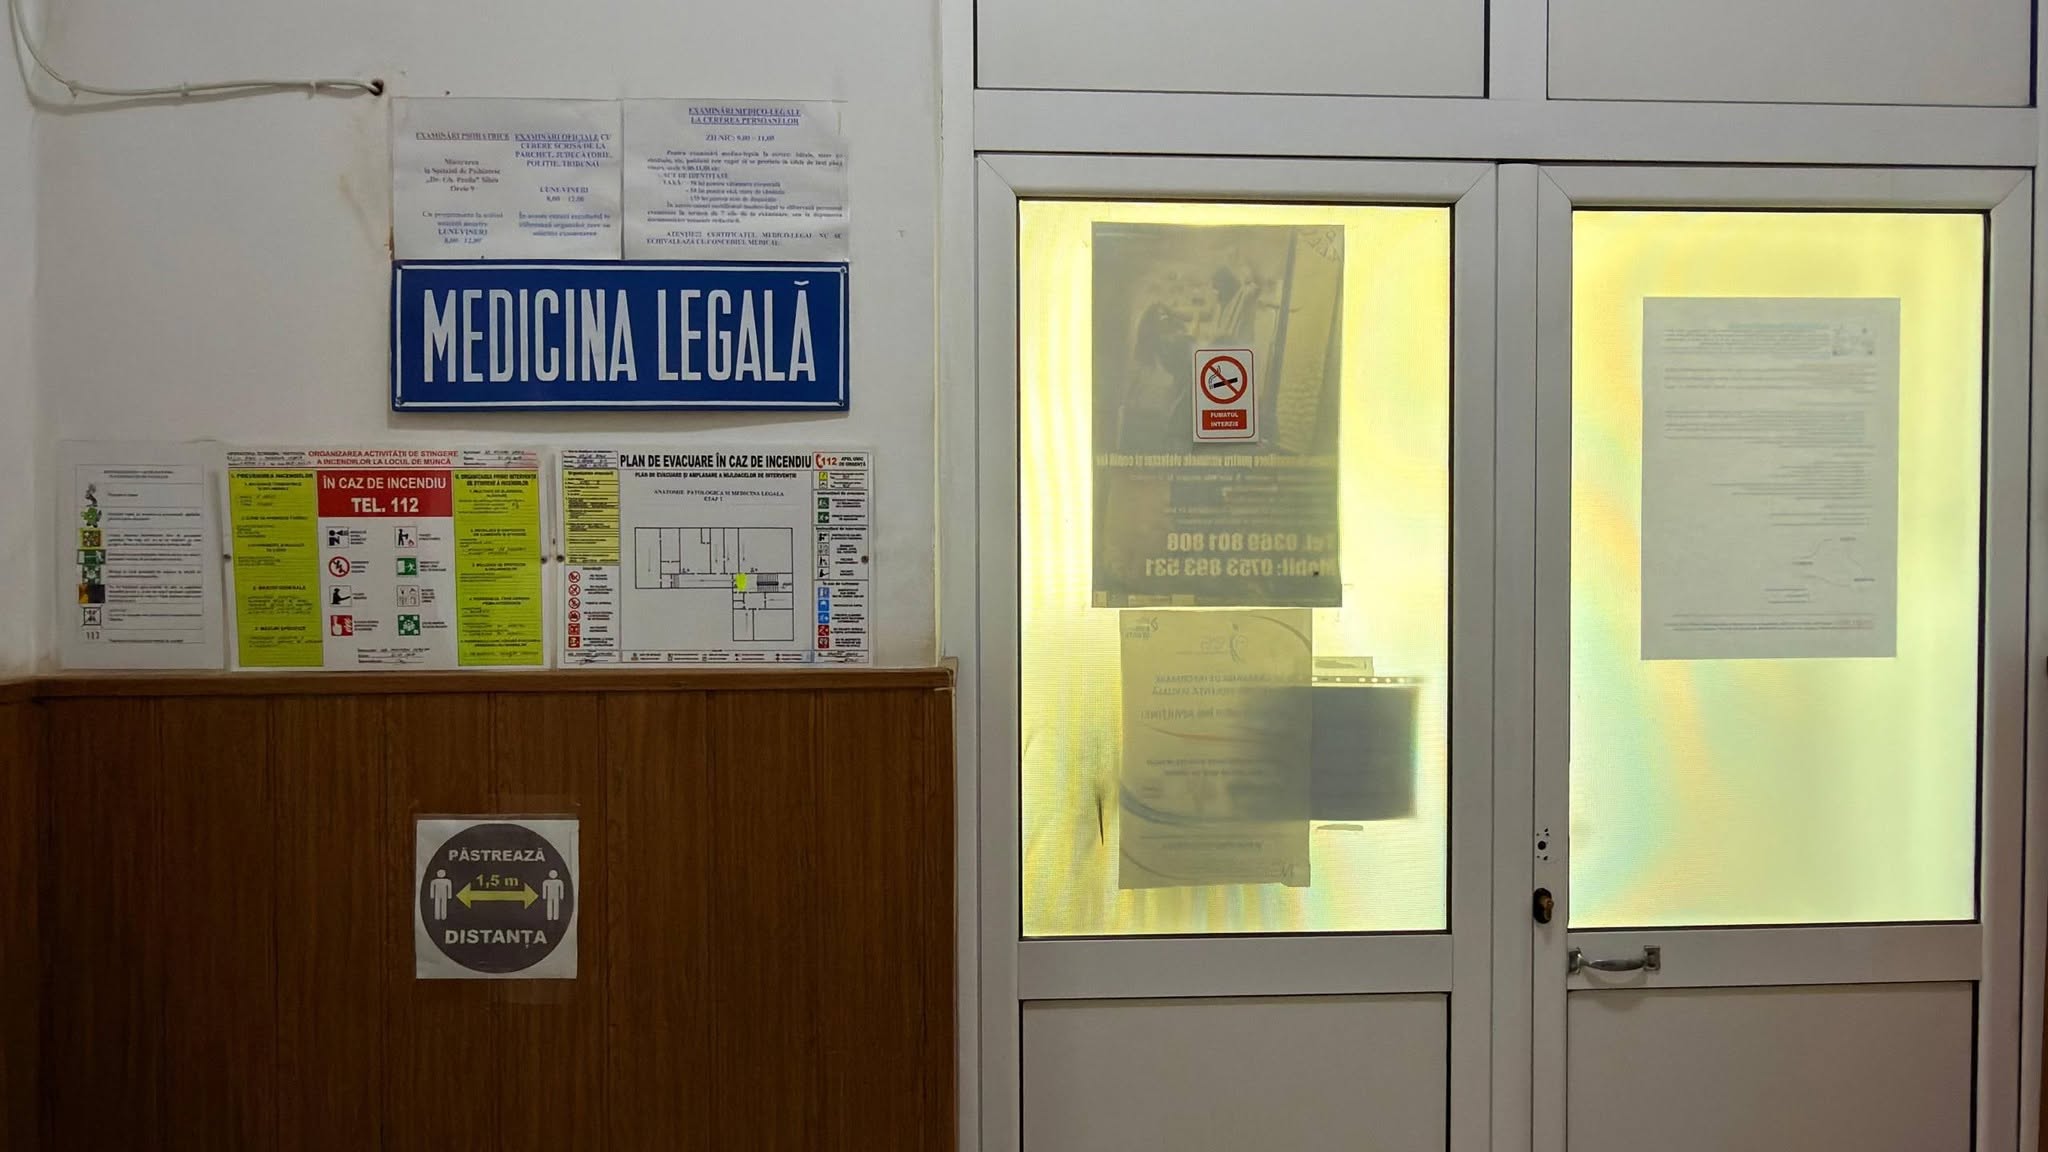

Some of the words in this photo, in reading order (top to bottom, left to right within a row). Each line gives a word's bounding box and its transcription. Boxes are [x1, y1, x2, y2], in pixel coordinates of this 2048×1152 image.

[424, 289, 638, 383] MEDICINA
[658, 280, 816, 382] LEGALĂ
[620, 455, 645, 467] PLAN
[648, 455, 661, 467] DE
[663, 455, 713, 467] EVACUARE
[716, 452, 727, 467] ÎN
[729, 455, 748, 467] CAZ
[751, 455, 763, 467] DE
[766, 455, 812, 468] INCENDIU
[821, 457, 837, 466] 112
[323, 475, 335, 489] ÎN
[338, 477, 364, 489] CAZ
[367, 477, 384, 489] DE
[388, 477, 447, 489] INCENDIU
[351, 497, 386, 513] TEL.
[391, 497, 419, 513] 112
[448, 847, 546, 862] PĂSTREAZĂ
[476, 874, 501, 889] 1,5
[504, 877, 519, 886] m
[445, 929, 548, 948] DISTANȚA
